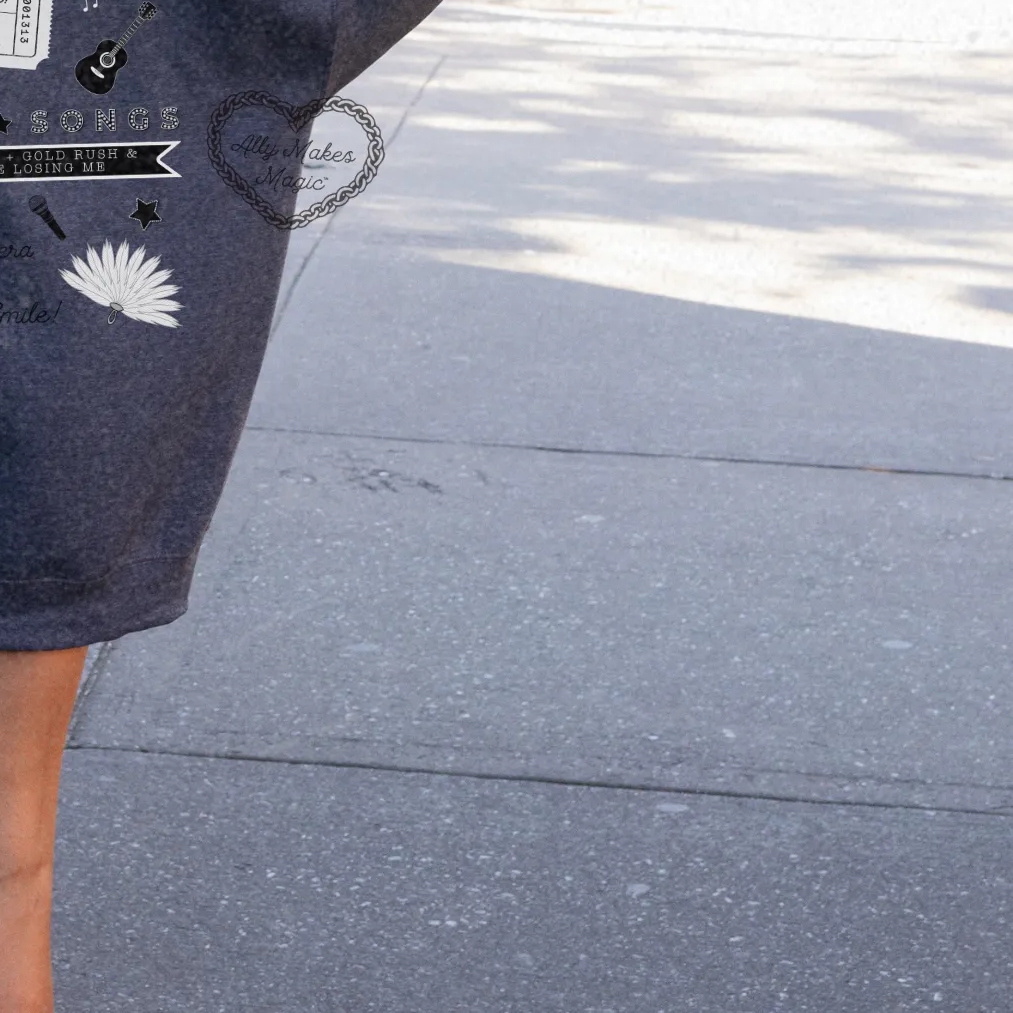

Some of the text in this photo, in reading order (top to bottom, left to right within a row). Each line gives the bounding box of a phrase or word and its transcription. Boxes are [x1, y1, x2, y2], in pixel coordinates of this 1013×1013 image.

[30, 107, 180, 134] SONGS
[22, 150, 66, 161] GOLD
[74, 148, 119, 160] RUSH
[126, 148, 137, 159] &
[13, 162, 74, 174] LOSING
[83, 161, 106, 172] ME
